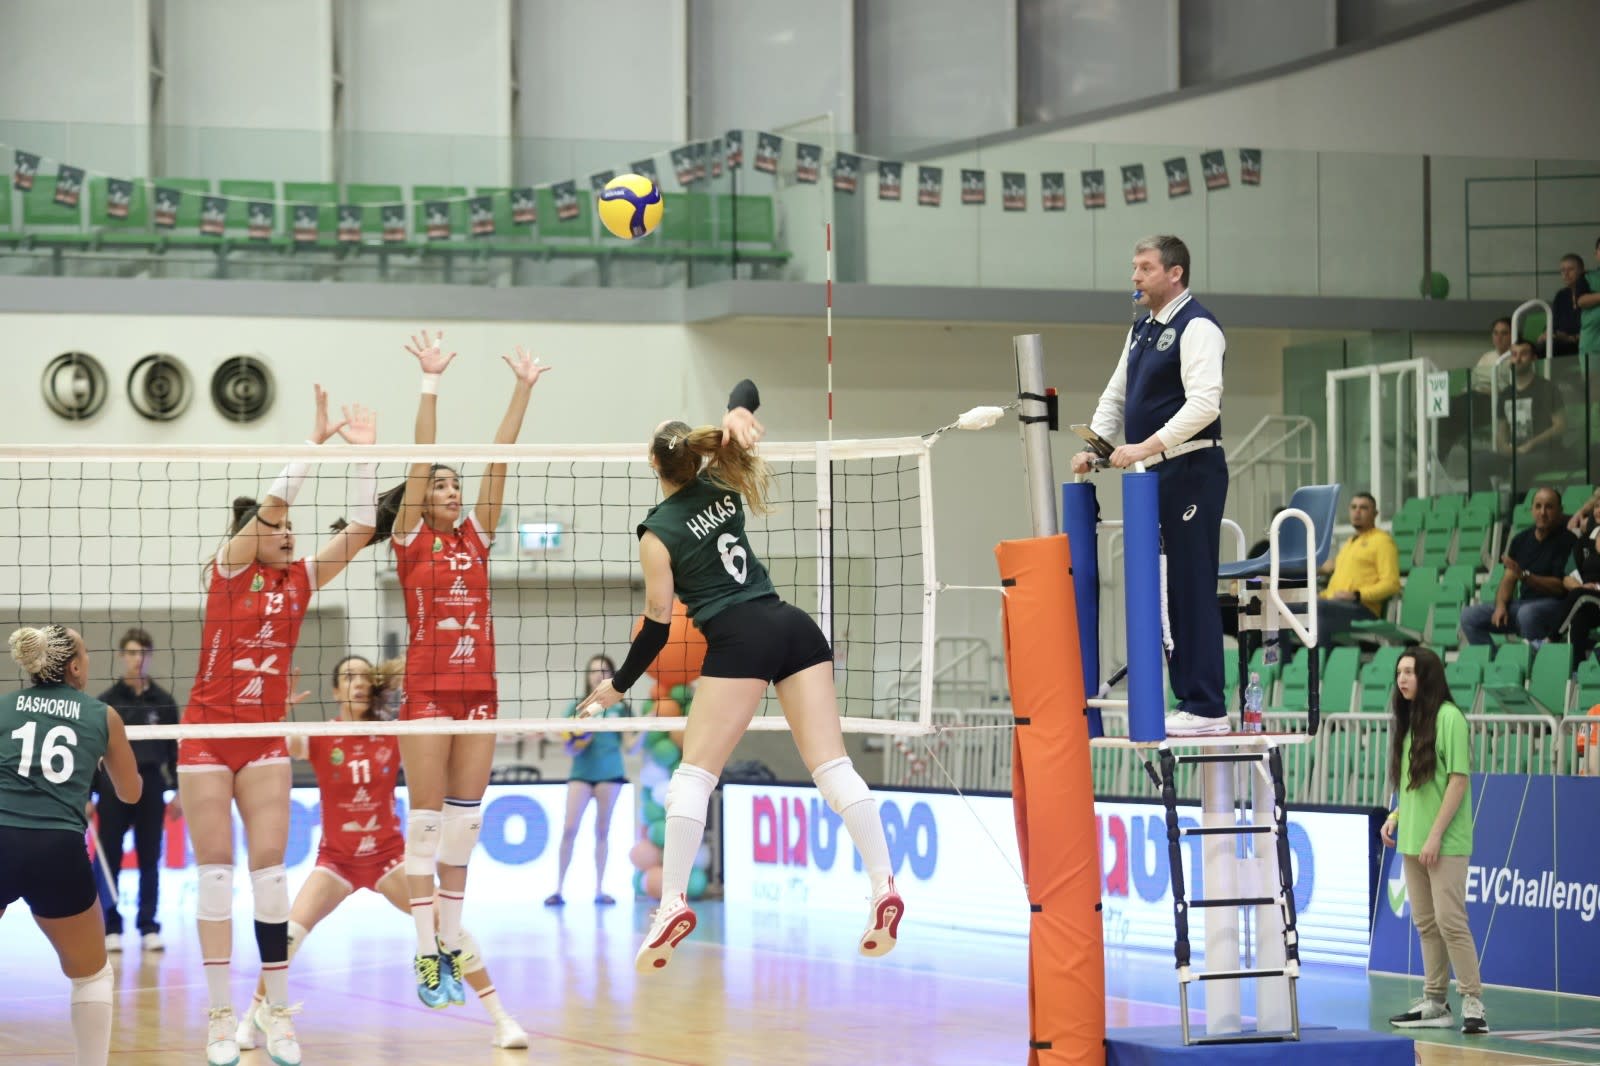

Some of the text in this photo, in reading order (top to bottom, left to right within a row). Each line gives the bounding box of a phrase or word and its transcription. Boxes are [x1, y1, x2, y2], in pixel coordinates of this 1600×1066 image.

[686, 495, 736, 540] HAKAS
[717, 533, 747, 585] 6
[16, 695, 81, 720] BASHORUN
[11, 721, 78, 784] 16
[347, 759, 371, 784] 11
[1465, 865, 1600, 922] EVChalleng
